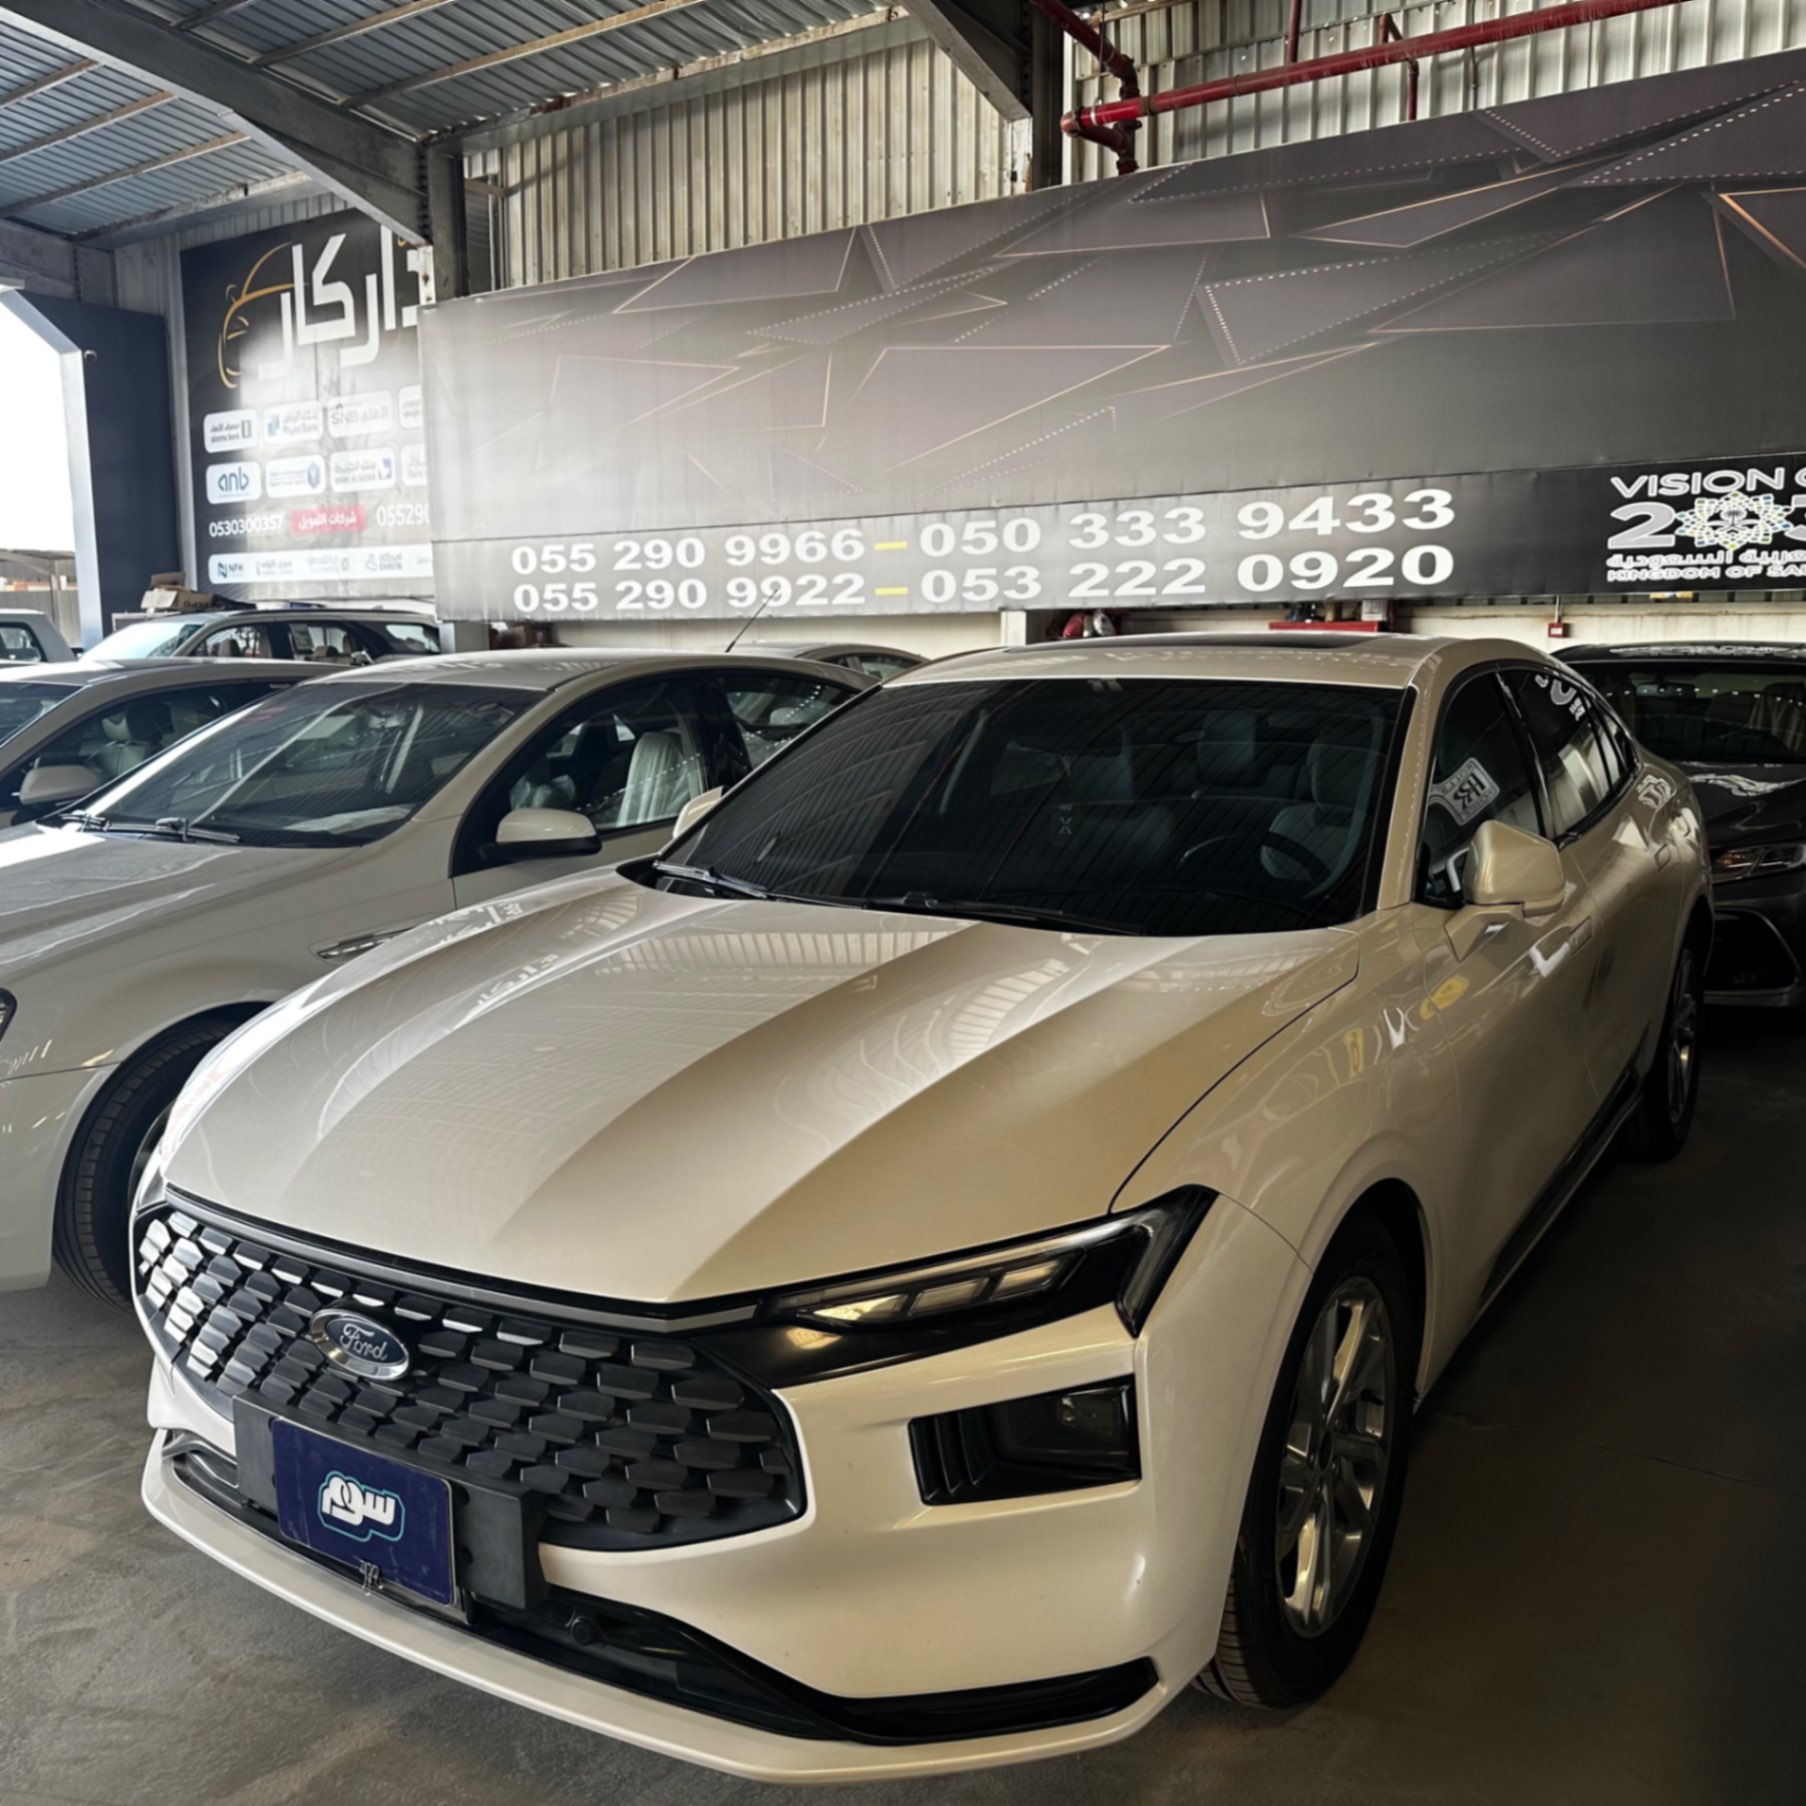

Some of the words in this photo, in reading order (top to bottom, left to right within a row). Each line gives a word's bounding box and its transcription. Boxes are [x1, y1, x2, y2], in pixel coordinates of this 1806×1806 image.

[218, 466, 249, 491] anb
[1610, 467, 1785, 498] VISION
[512, 542, 597, 575] 055
[613, 537, 706, 571] 290
[724, 528, 866, 567] 9966
[920, 516, 1042, 557] 050
[1068, 506, 1207, 549] 333
[1236, 488, 1455, 540] 9433
[513, 581, 599, 613] 055
[615, 578, 707, 611] 290
[726, 572, 867, 609] 9922
[920, 565, 1042, 603] 053
[1068, 557, 1207, 598] 222
[1236, 544, 1455, 593] 0920
[1607, 566, 1721, 582] KINGDOM
[1725, 565, 1763, 578] OF
[340, 1322, 388, 1361] Ford
